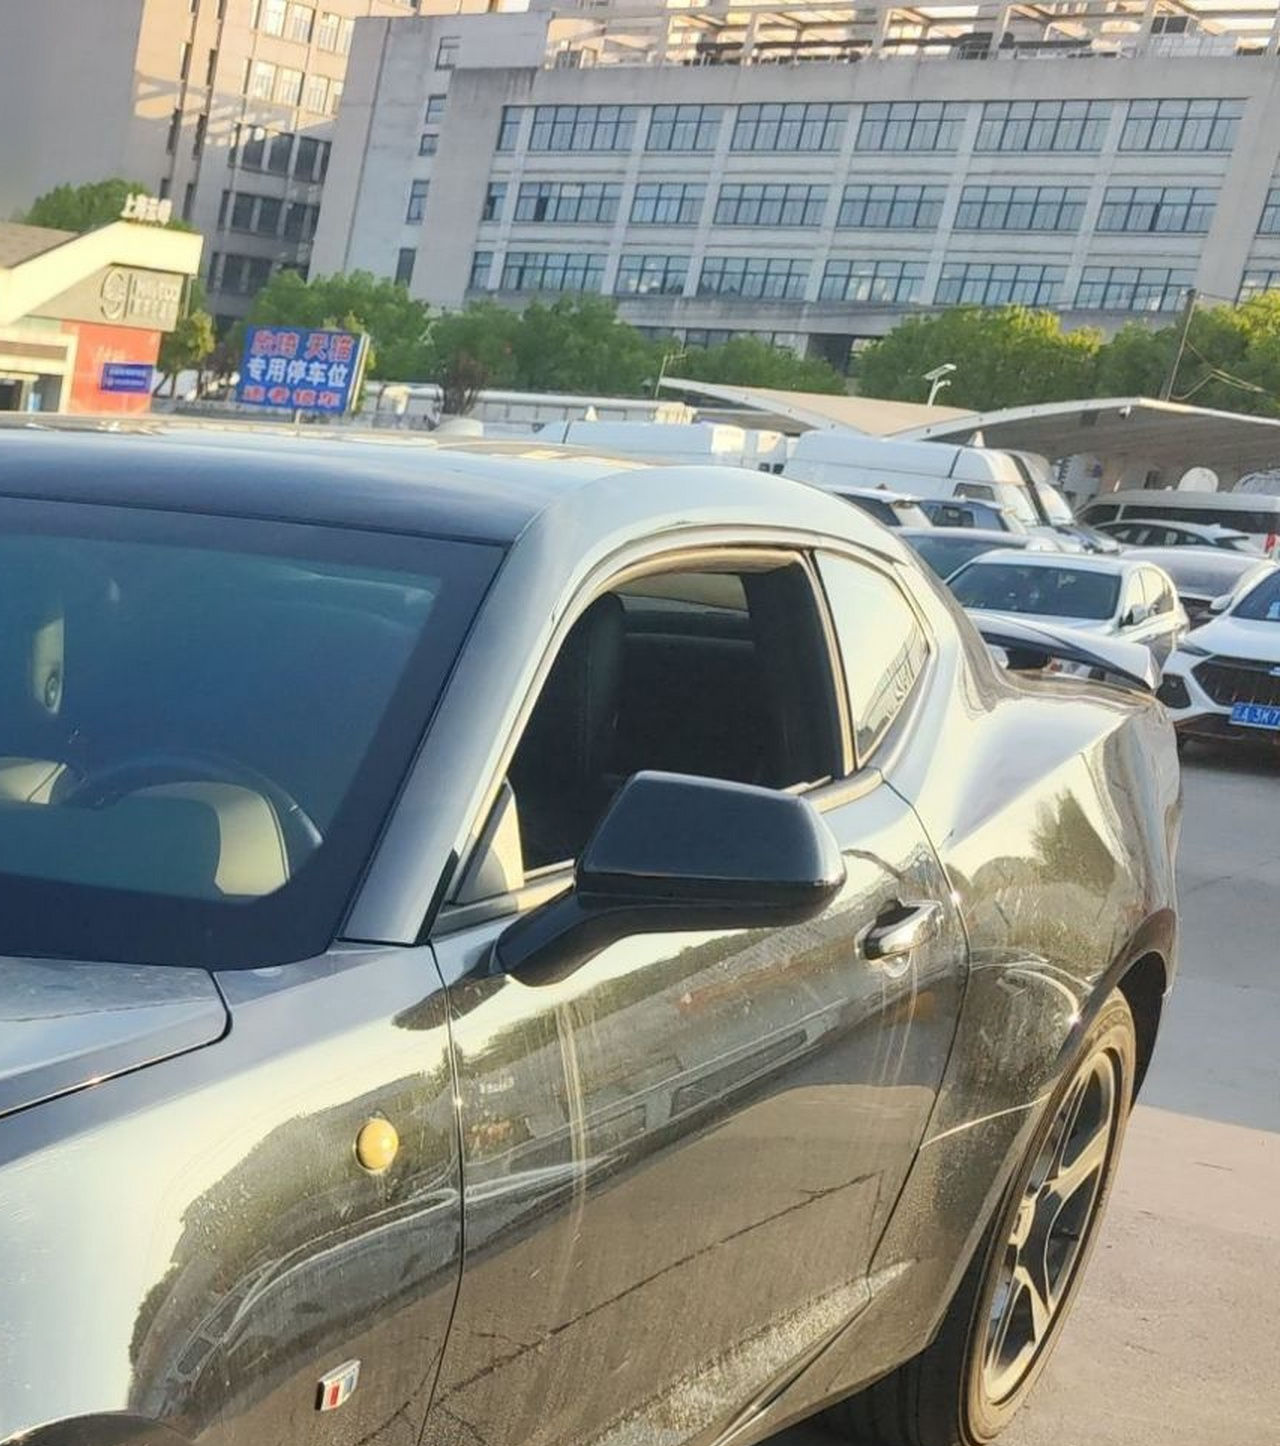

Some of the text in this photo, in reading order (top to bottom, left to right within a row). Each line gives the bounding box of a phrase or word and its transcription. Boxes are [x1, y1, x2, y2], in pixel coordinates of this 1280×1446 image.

[247, 357, 348, 387] 专用停车位
